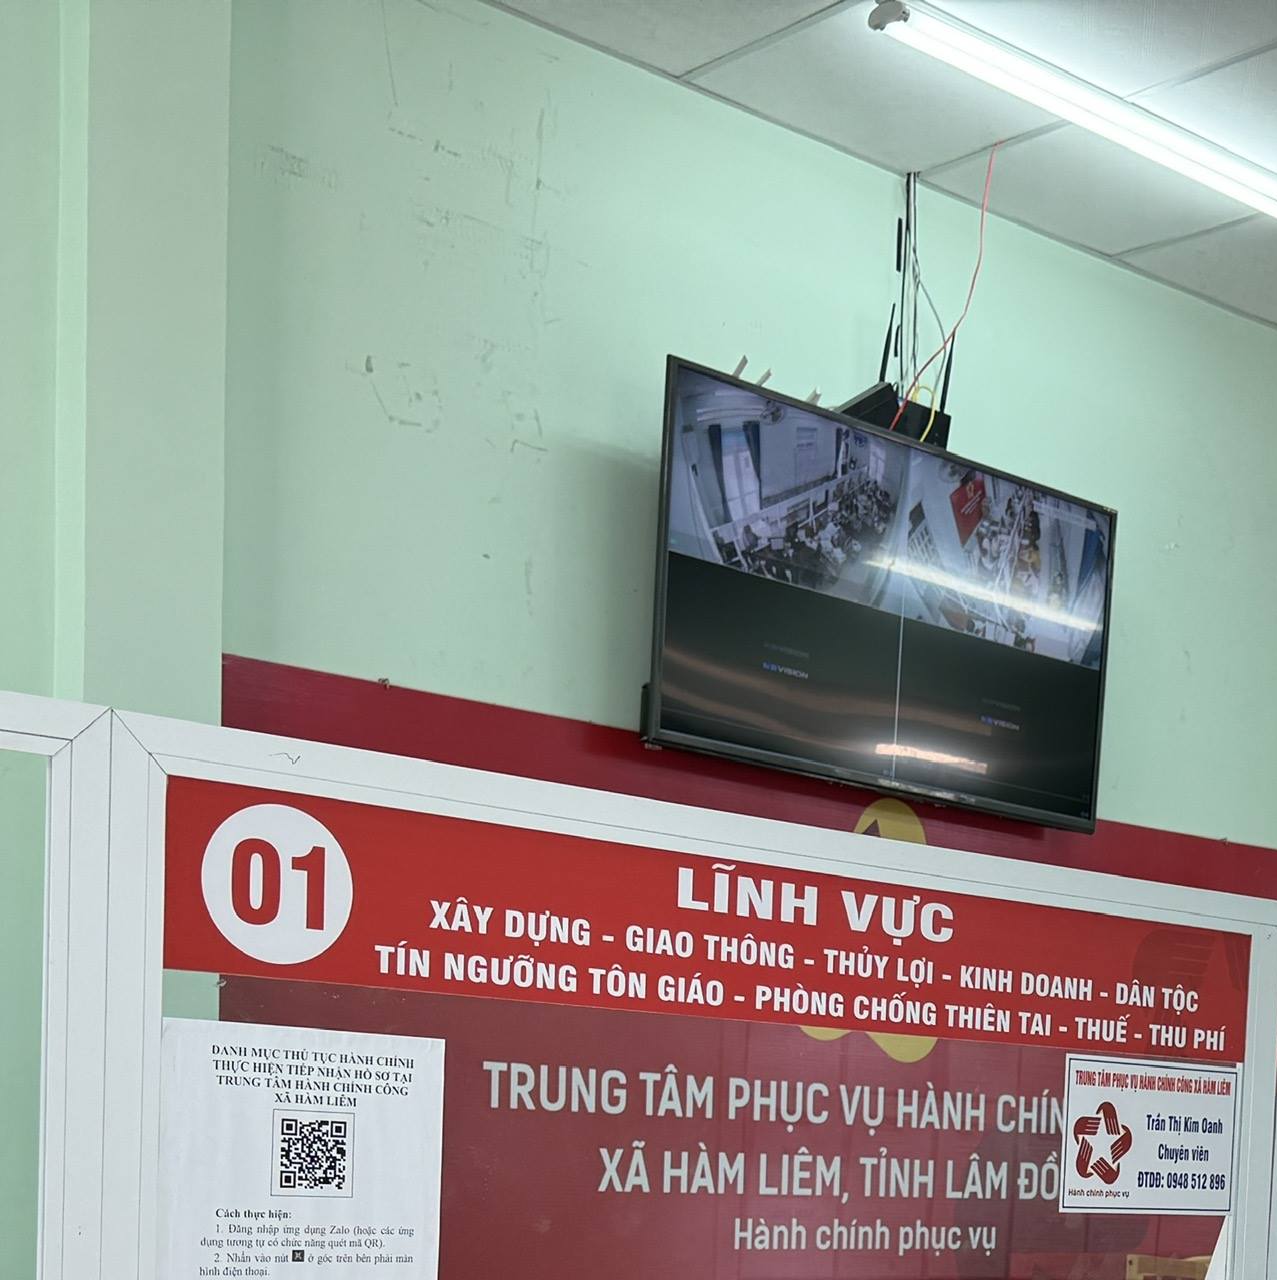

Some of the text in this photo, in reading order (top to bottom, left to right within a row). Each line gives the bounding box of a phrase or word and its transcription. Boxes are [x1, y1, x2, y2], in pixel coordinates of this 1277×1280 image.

[231, 837, 325, 931] 01
[678, 863, 953, 946] LĨNH VỰC
[429, 897, 1199, 1015] XÂY DỰNG GIAO THÔNG THỦY LỢI KINH DOANH DÂN TỘC
[374, 940, 1227, 1052] TÍN NGƯỠNG TÔN GIÁO PHÒNG CHỐNG THIÊN TAI THUẾ THU PHÍ
[212, 1045, 414, 1068] DANH MỤC THỦ TỤC HÀNH CHÍNH
[213, 1060, 412, 1083] THỰC HIỆN TIẾP NHẬN HỒ SƠ TẠI
[1076, 1070, 1096, 1086] TRUNG
[1098, 1069, 1111, 1087] TÂM
[1112, 1072, 1128, 1091] PHỤC
[1130, 1075, 1137, 1092] VỤ
[1158, 1074, 1175, 1092] CHÍNH
[1194, 1075, 1202, 1093] XÃ
[1217, 1079, 1231, 1096] LIÊM
[216, 1075, 409, 1096] TRUNG TÂM HÀNH CHÍNH CÔNG
[274, 1092, 357, 1107] XÃ HÀM LIÊM
[483, 1061, 1064, 1136] TRUNG TÂM PHỤC VỤ HÀNH CHÍN
[1168, 1116, 1181, 1135] Thị
[1184, 1117, 1199, 1132] Kim
[1202, 1118, 1222, 1134] Oanh
[1158, 1144, 1208, 1163] Chuyên viên
[598, 1141, 1060, 1205] XÃ HÀM LIÊM, TỈNH LÂM ĐỒ
[1138, 1172, 1225, 1190] ĐTDĐ: 0948 512 896
[1068, 1188, 1085, 1196] Hành
[1087, 1189, 1103, 1197] chính
[1105, 1189, 1120, 1198] phục
[216, 1209, 292, 1221] Cách thực hiện:
[734, 1216, 996, 1258] Hành chính phục vụ
